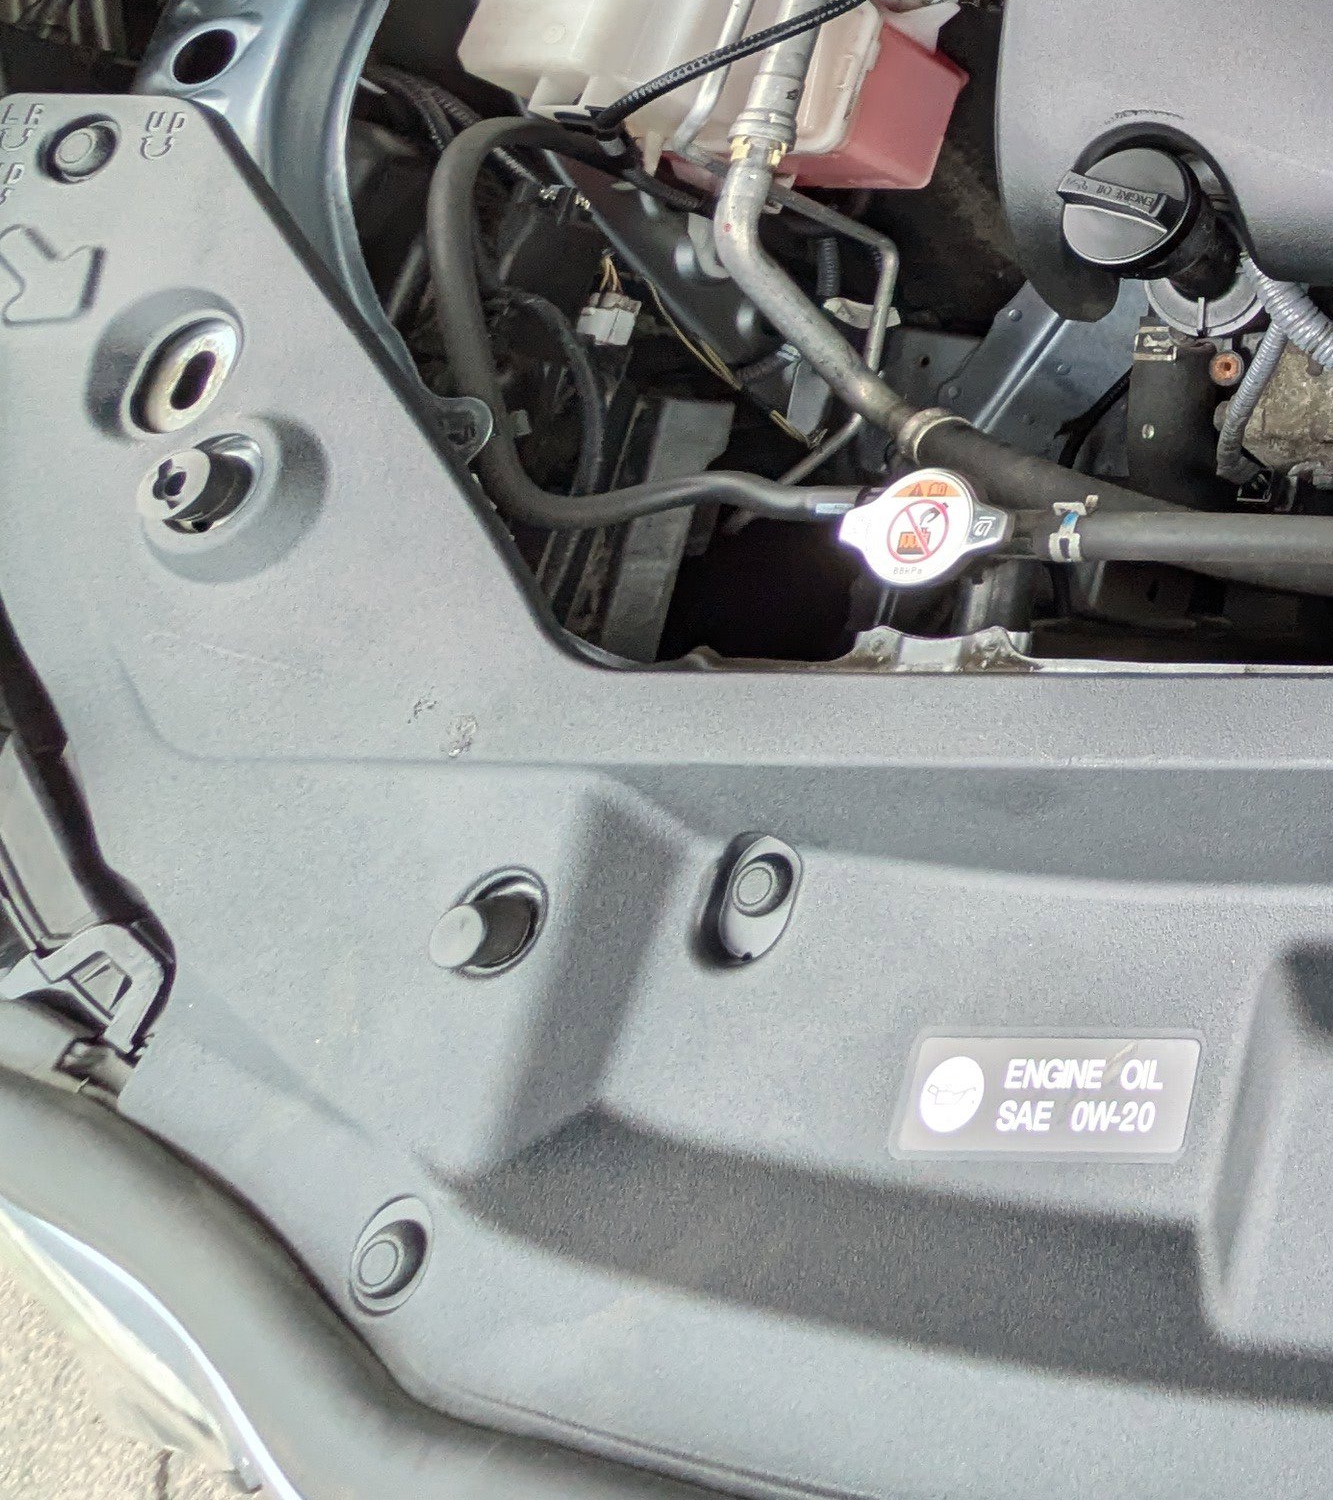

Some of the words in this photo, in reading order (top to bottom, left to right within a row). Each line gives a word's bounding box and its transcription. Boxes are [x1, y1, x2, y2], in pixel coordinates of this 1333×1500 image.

[1004, 1058, 1106, 1090] ENGINE
[1120, 1058, 1164, 1091] OIL
[995, 1100, 1055, 1132] SAE
[1070, 1100, 1156, 1133] 0W-20
